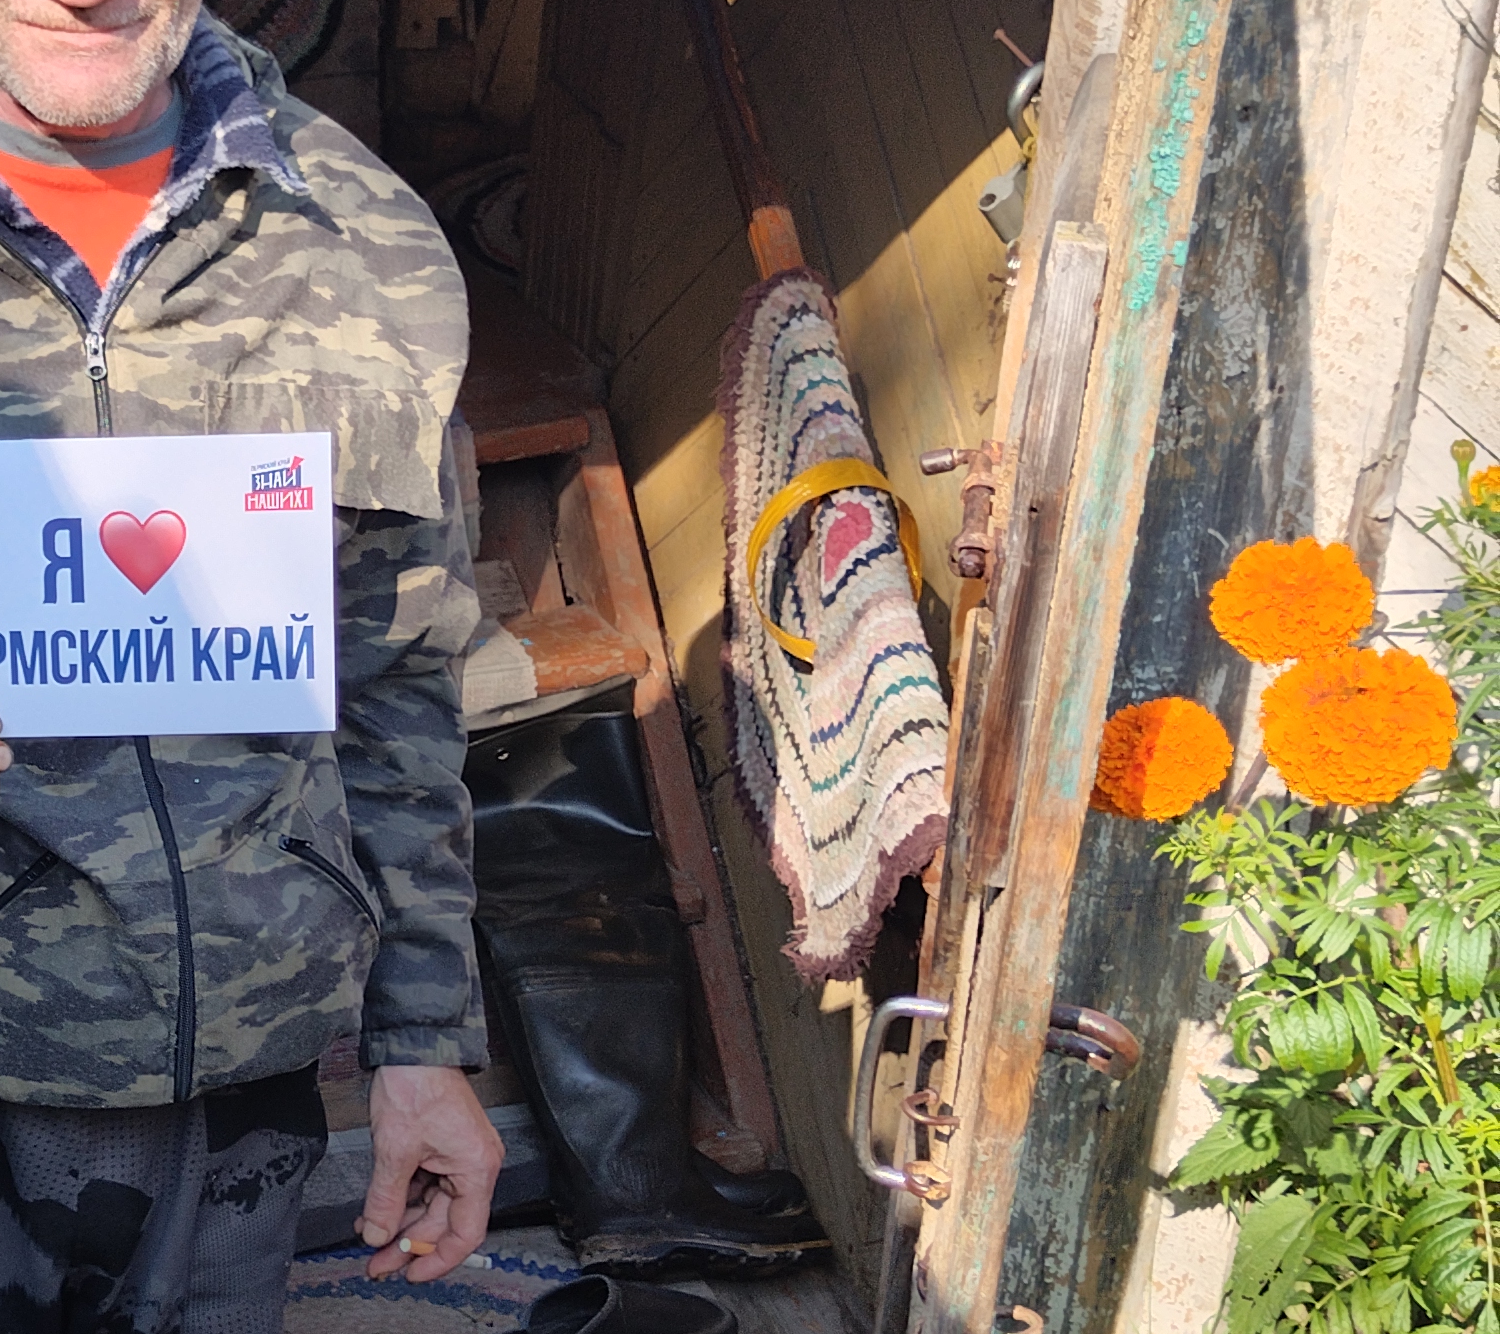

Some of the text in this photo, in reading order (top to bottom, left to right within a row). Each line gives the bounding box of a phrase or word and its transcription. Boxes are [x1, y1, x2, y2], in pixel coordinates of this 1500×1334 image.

[247, 489, 308, 509] НАШИХ!
[42, 518, 85, 604] Я
[192, 613, 315, 682] КРАЙ
